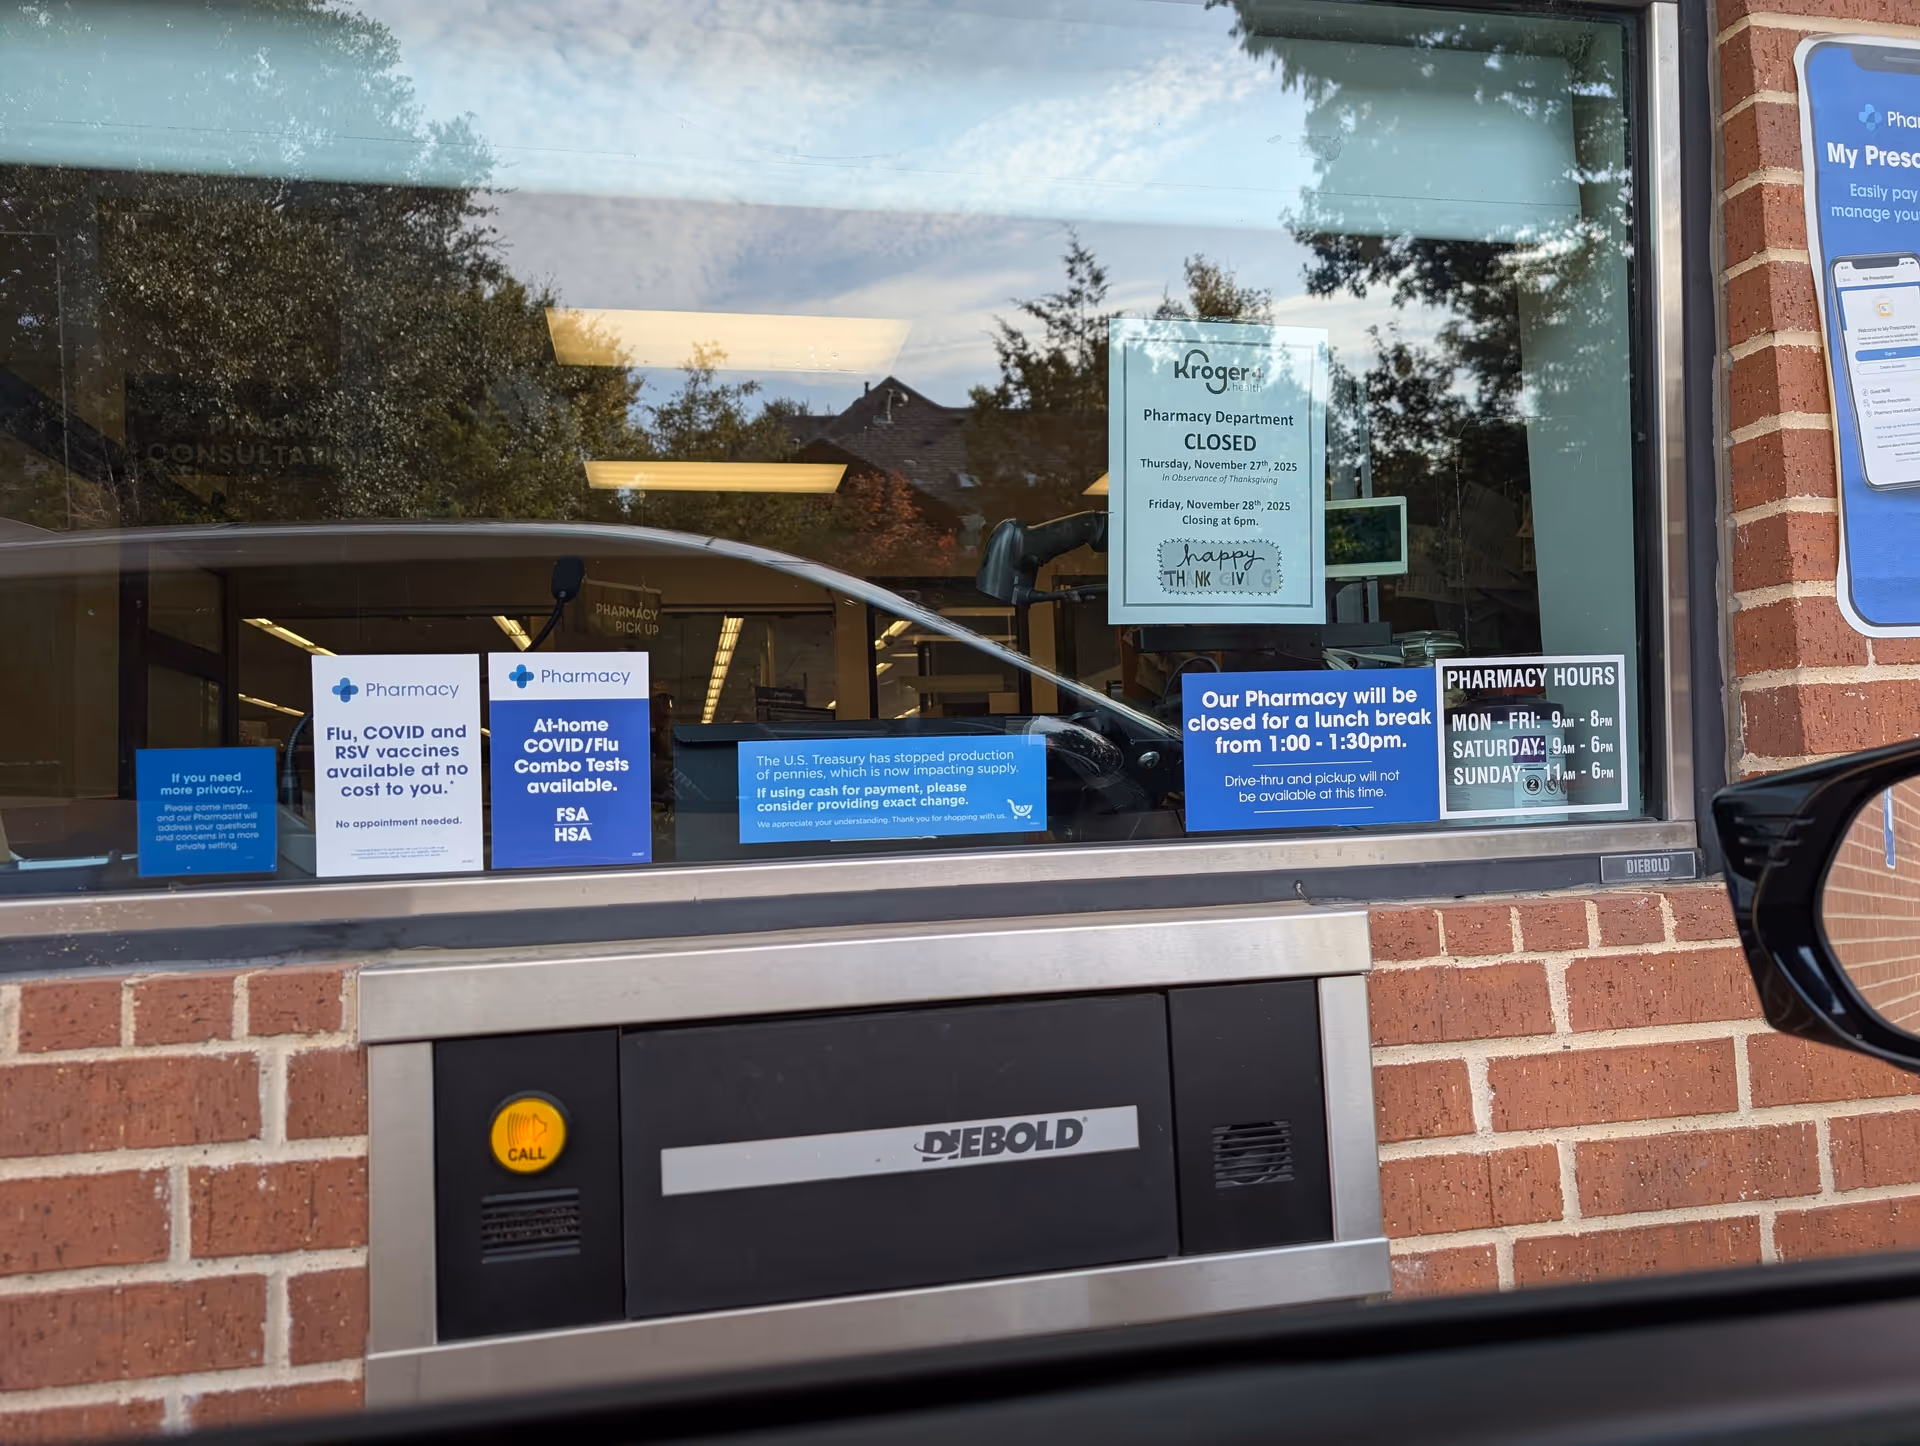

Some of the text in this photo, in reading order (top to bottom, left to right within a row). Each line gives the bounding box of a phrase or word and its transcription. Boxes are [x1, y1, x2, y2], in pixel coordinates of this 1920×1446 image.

[1827, 142, 1858, 169] My
[1850, 183, 1918, 203] Easily pay
[1831, 205, 1920, 223] manage you
[1174, 349, 1250, 394] Kroger
[1232, 382, 1263, 393] health
[1144, 408, 1294, 427] Pharmacy Department
[1184, 433, 1257, 451] CLOSED
[1140, 458, 1191, 471] Thursday,
[1194, 459, 1247, 470] November
[1274, 462, 1297, 472] 2025
[1162, 473, 1278, 485] In Observance of Thanksgiving
[1149, 499, 1184, 512] Friday,
[1186, 500, 1240, 510] November
[1266, 501, 1290, 511] 2025
[1182, 515, 1259, 527] Closing at 6pm.
[1176, 543, 1265, 571] happy
[596, 603, 658, 620] PHARMACY
[615, 620, 659, 635] PICK UP
[541, 669, 631, 685] Pharmacy
[1446, 666, 1615, 690] PHARMACY HOURS
[366, 682, 460, 699] Pharmacy
[1202, 686, 1418, 708] Our Pharmacy will be
[533, 717, 609, 733] At-home
[1187, 708, 1432, 731] closed for a lunch break
[1452, 713, 1491, 732] MON
[1509, 711, 1541, 729] FRI:
[1551, 711, 1575, 729] 9AM
[1590, 709, 1613, 727] 8PM
[326, 724, 466, 743] Flu, COVID and
[523, 737, 619, 753] COVID/Flu
[1215, 736, 1262, 753] from
[1269, 734, 1310, 752] 1:00
[1329, 732, 1407, 752] 1:30pm.
[1453, 737, 1545, 759] SATURDAY:
[1552, 737, 1575, 755] 9AM
[1591, 735, 1613, 753] 6PM
[335, 743, 460, 759] RSV vaccines
[756, 750, 1014, 766] The U.S. Treasury has stopped production
[326, 762, 468, 779] available at no
[514, 757, 629, 773] Combo Tests
[756, 763, 1019, 782] of pennies, which is now impacting supply.
[171, 772, 242, 784] If you need
[1224, 769, 1400, 787] Drive-thru and pickup will not
[1453, 765, 1526, 786] SUNDAY:
[1543, 763, 1576, 781] 11AM
[1592, 762, 1614, 780] 6PM
[160, 785, 253, 796] more privacy...
[341, 782, 380, 797] cost
[386, 782, 404, 796] to
[527, 778, 618, 793] available.
[757, 782, 967, 799] If using cash for payment, please
[1529, 780, 1536, 788] 2
[1239, 786, 1387, 803] be available at this time.
[164, 804, 193, 812] Please
[757, 795, 969, 812] consider providing exact change.
[156, 814, 175, 822] and
[193, 812, 242, 821] Pharmacist
[556, 807, 589, 822] FSA
[757, 820, 770, 828] We
[772, 819, 813, 829] appreciate
[815, 819, 832, 828] your
[834, 817, 890, 826] understanding.
[892, 815, 914, 823] Thank
[916, 816, 930, 824] you
[943, 813, 978, 823] shopping
[979, 812, 995, 820] with
[158, 822, 257, 832] address your questions
[335, 816, 462, 830] No appointment needed.
[175, 833, 216, 841] concerns
[218, 832, 226, 840] in
[554, 827, 592, 842] HSA
[175, 842, 240, 851] private setting.
[1626, 857, 1670, 874] DIEBOLD
[913, 1118, 1084, 1163] DIEBOLD
[507, 1146, 547, 1162] CALL
